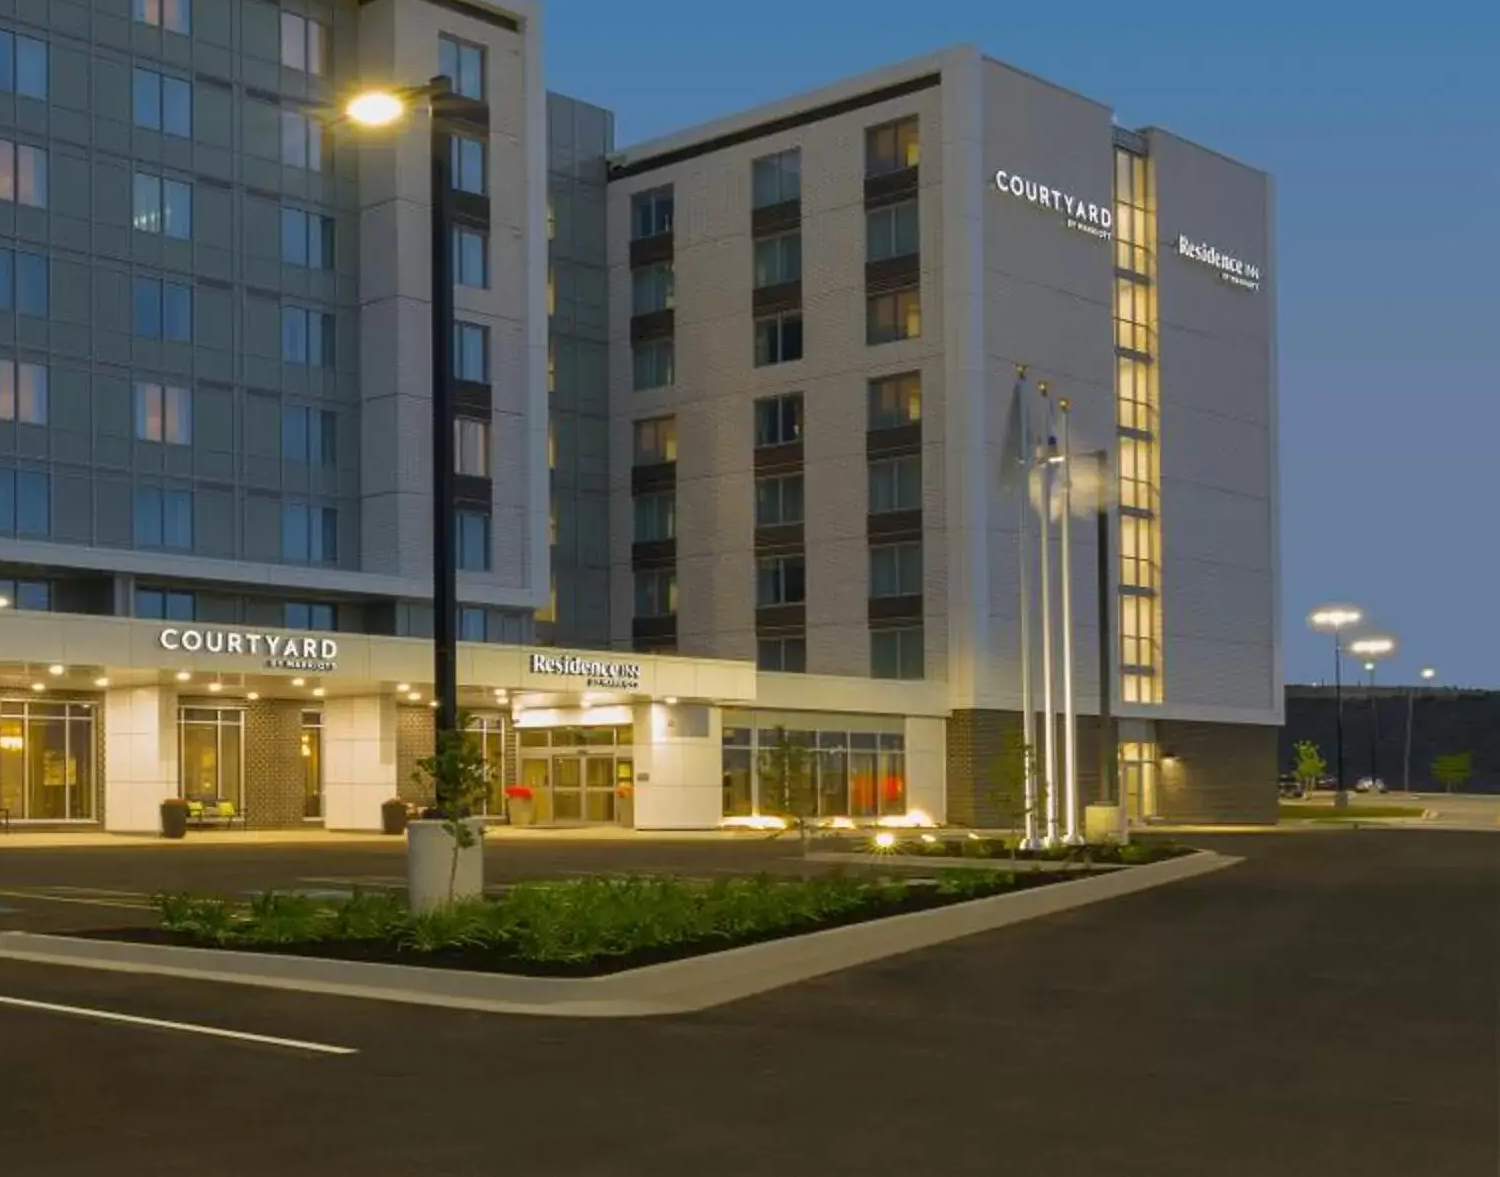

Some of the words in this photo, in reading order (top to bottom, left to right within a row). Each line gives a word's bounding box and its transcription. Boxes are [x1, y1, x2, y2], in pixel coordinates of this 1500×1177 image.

[995, 169, 1112, 228] COURTYARD
[1179, 233, 1243, 276] Residence
[160, 628, 338, 659] COURTYARD
[530, 653, 619, 678] Residence
